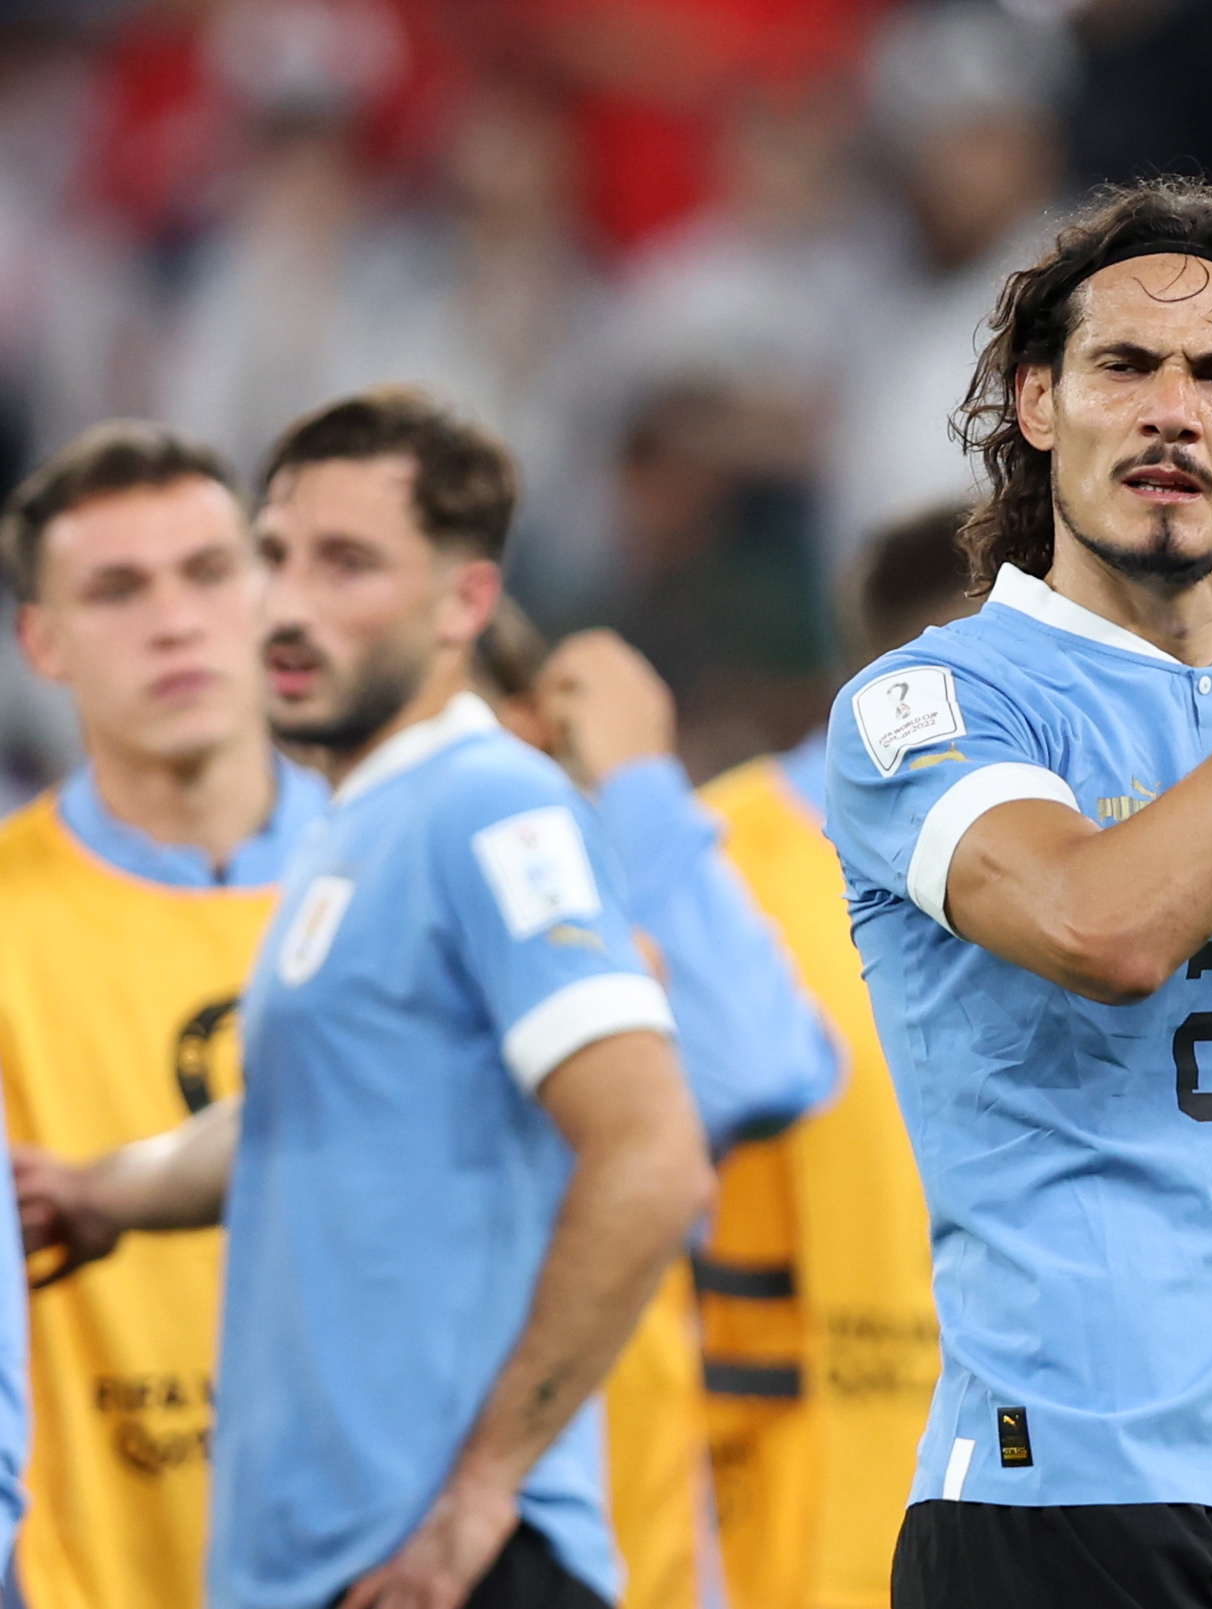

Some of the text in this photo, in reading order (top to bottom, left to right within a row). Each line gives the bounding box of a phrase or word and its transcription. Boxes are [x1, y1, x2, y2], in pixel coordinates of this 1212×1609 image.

[879, 711, 938, 745] FIFA WORLD CUP
